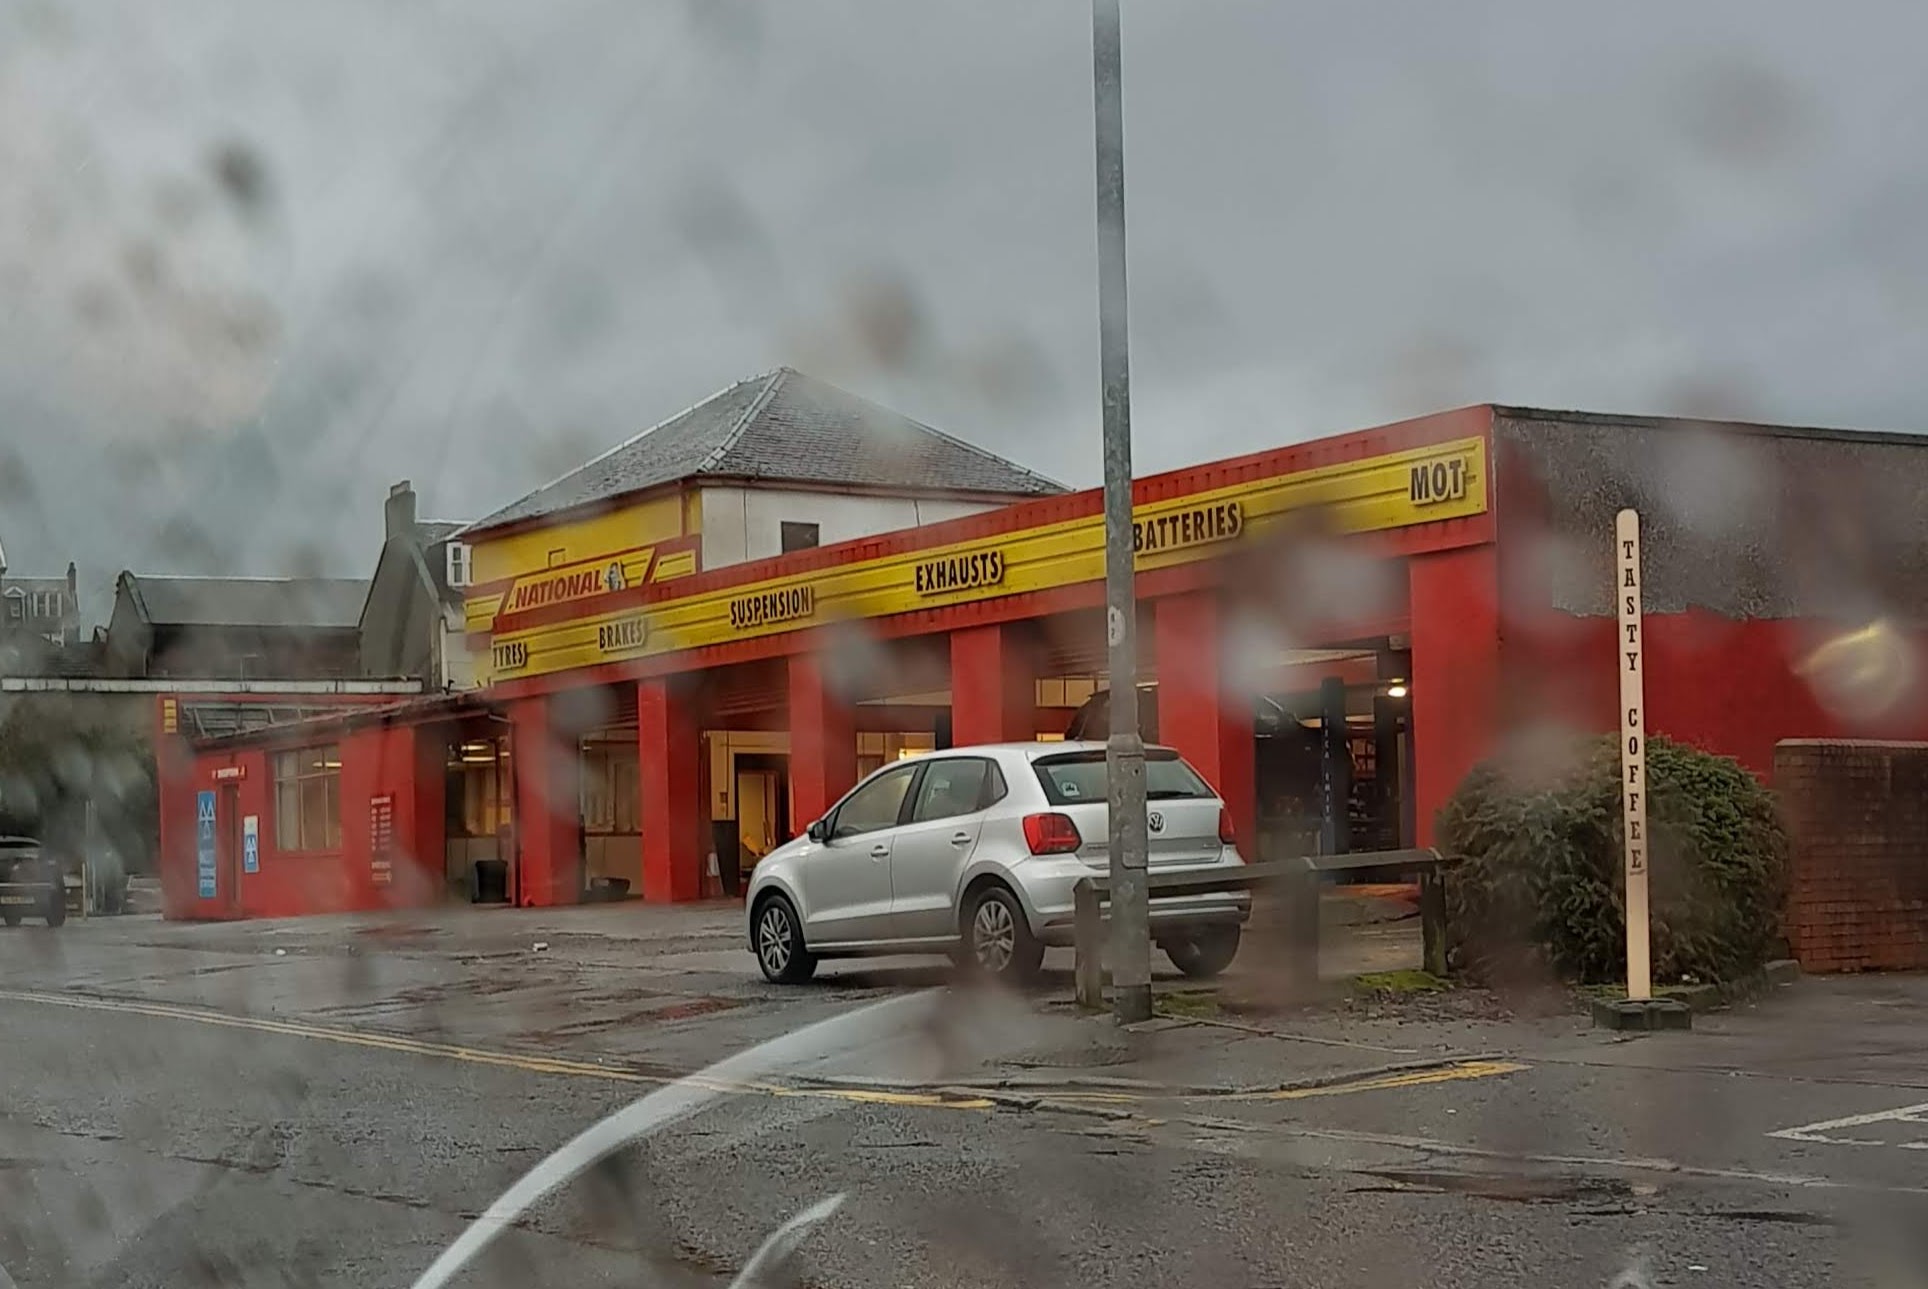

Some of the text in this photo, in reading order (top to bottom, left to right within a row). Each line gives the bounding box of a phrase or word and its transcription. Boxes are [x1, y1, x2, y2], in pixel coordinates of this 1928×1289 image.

[1410, 459, 1462, 501] MOT
[1132, 503, 1239, 552] BATTERIES
[515, 569, 603, 609] NATIONAL
[915, 551, 999, 592] EXHAUSTS
[730, 586, 810, 625] SUSPENSION
[599, 618, 643, 649] BRAKES
[492, 642, 523, 668] TYRES
[1623, 540, 1641, 869] TASTY COFFEE
